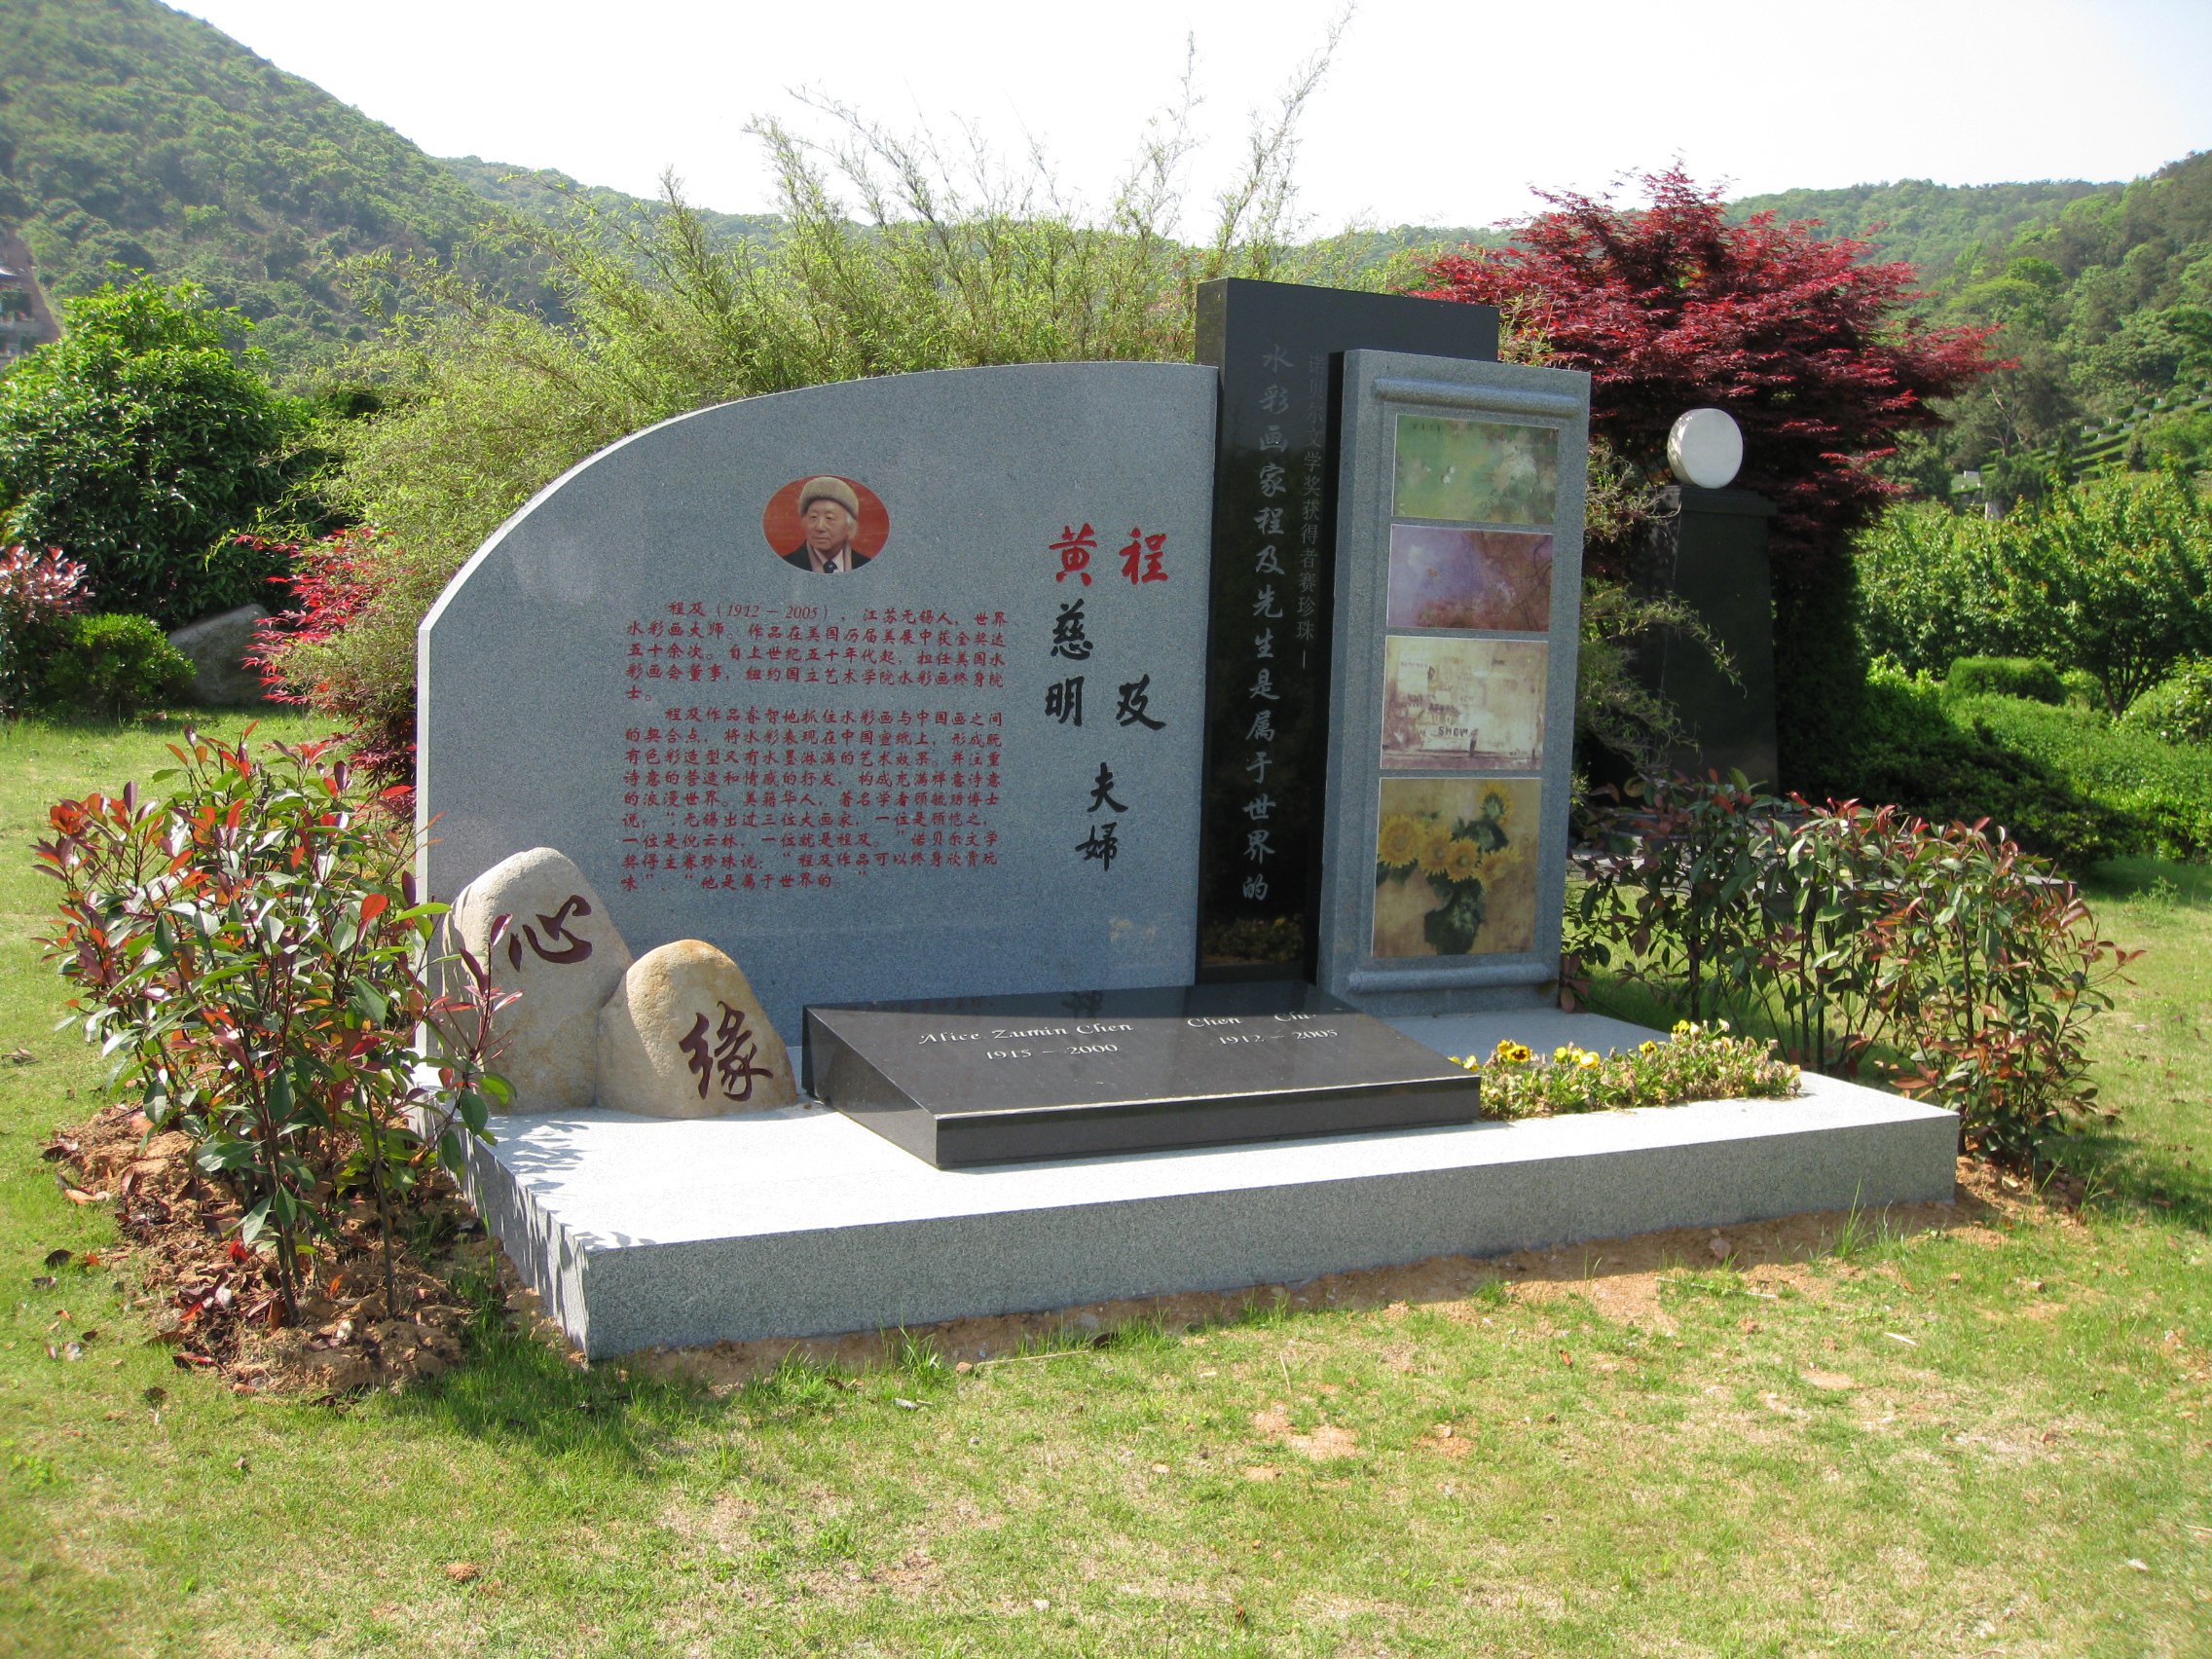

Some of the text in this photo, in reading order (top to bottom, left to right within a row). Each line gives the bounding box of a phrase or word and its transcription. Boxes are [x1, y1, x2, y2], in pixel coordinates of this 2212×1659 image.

[1242, 344, 1293, 902] 水彩画家程及先生是属于世界的
[1075, 761, 1128, 871] 夫婦
[508, 894, 593, 973] 心
[918, 1022, 1134, 1045] Alice Zumin Chen
[1187, 1016, 1242, 1028] Chen
[1219, 1033, 1265, 1045] 1912
[1292, 1029, 1339, 1041] 2005
[985, 1049, 1032, 1060] 1915
[1066, 1044, 1119, 1055] 2000
